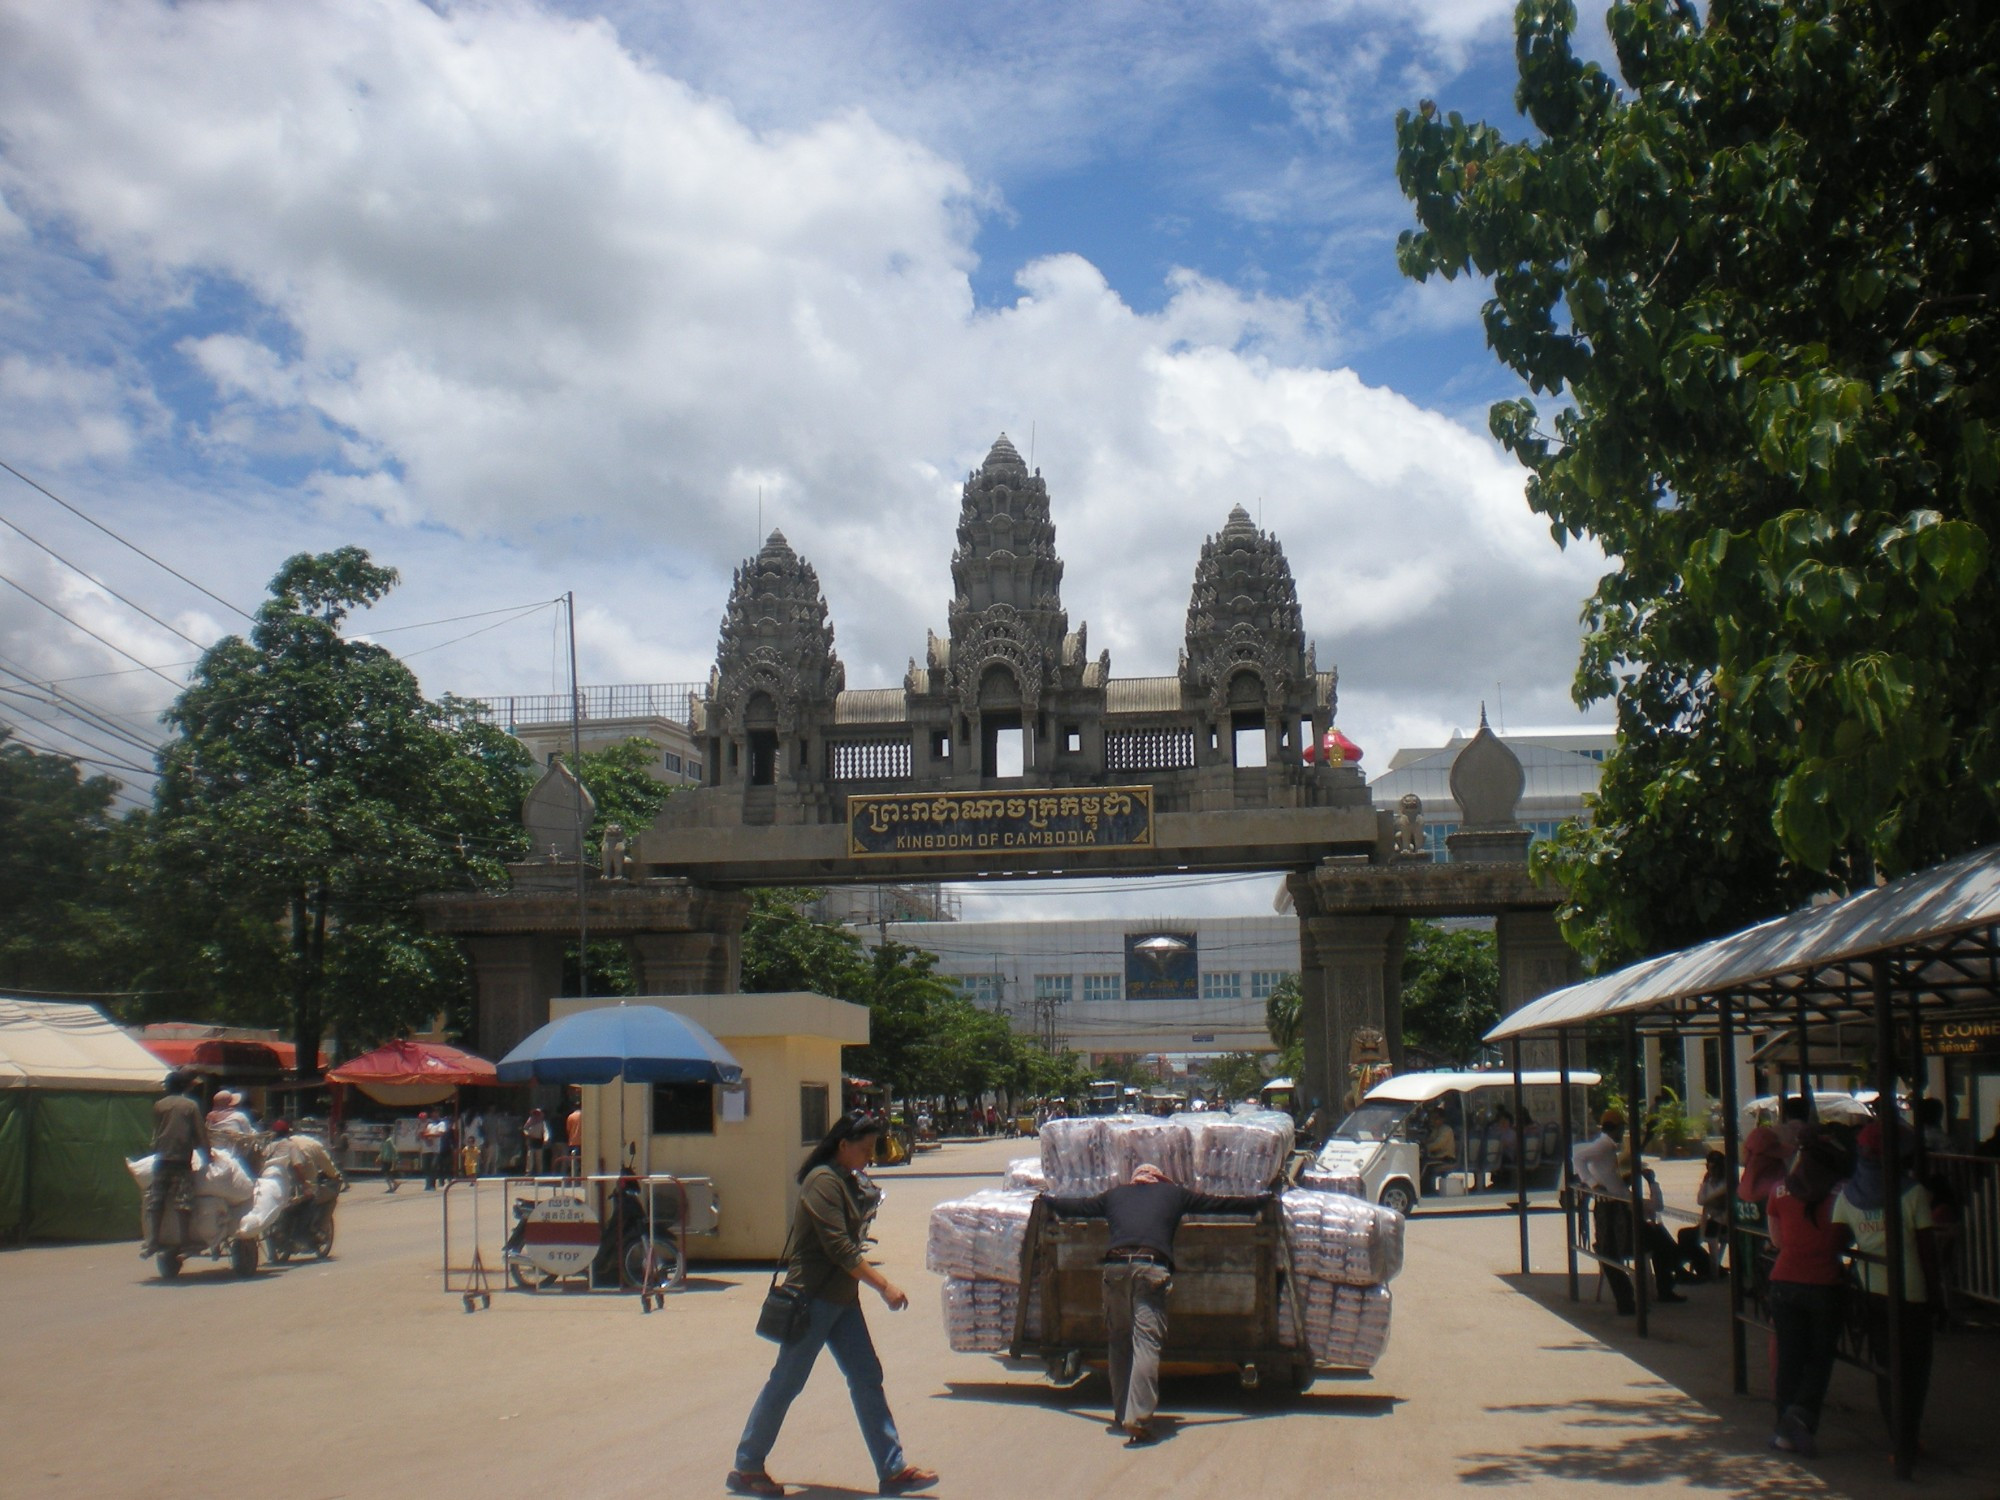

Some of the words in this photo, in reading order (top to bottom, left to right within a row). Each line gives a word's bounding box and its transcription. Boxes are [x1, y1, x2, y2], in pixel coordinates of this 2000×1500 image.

[896, 833, 973, 849] KINGDOM
[978, 832, 999, 847] OF
[1004, 830, 1096, 847] CAMBODIA
[547, 1251, 580, 1262] STOP
